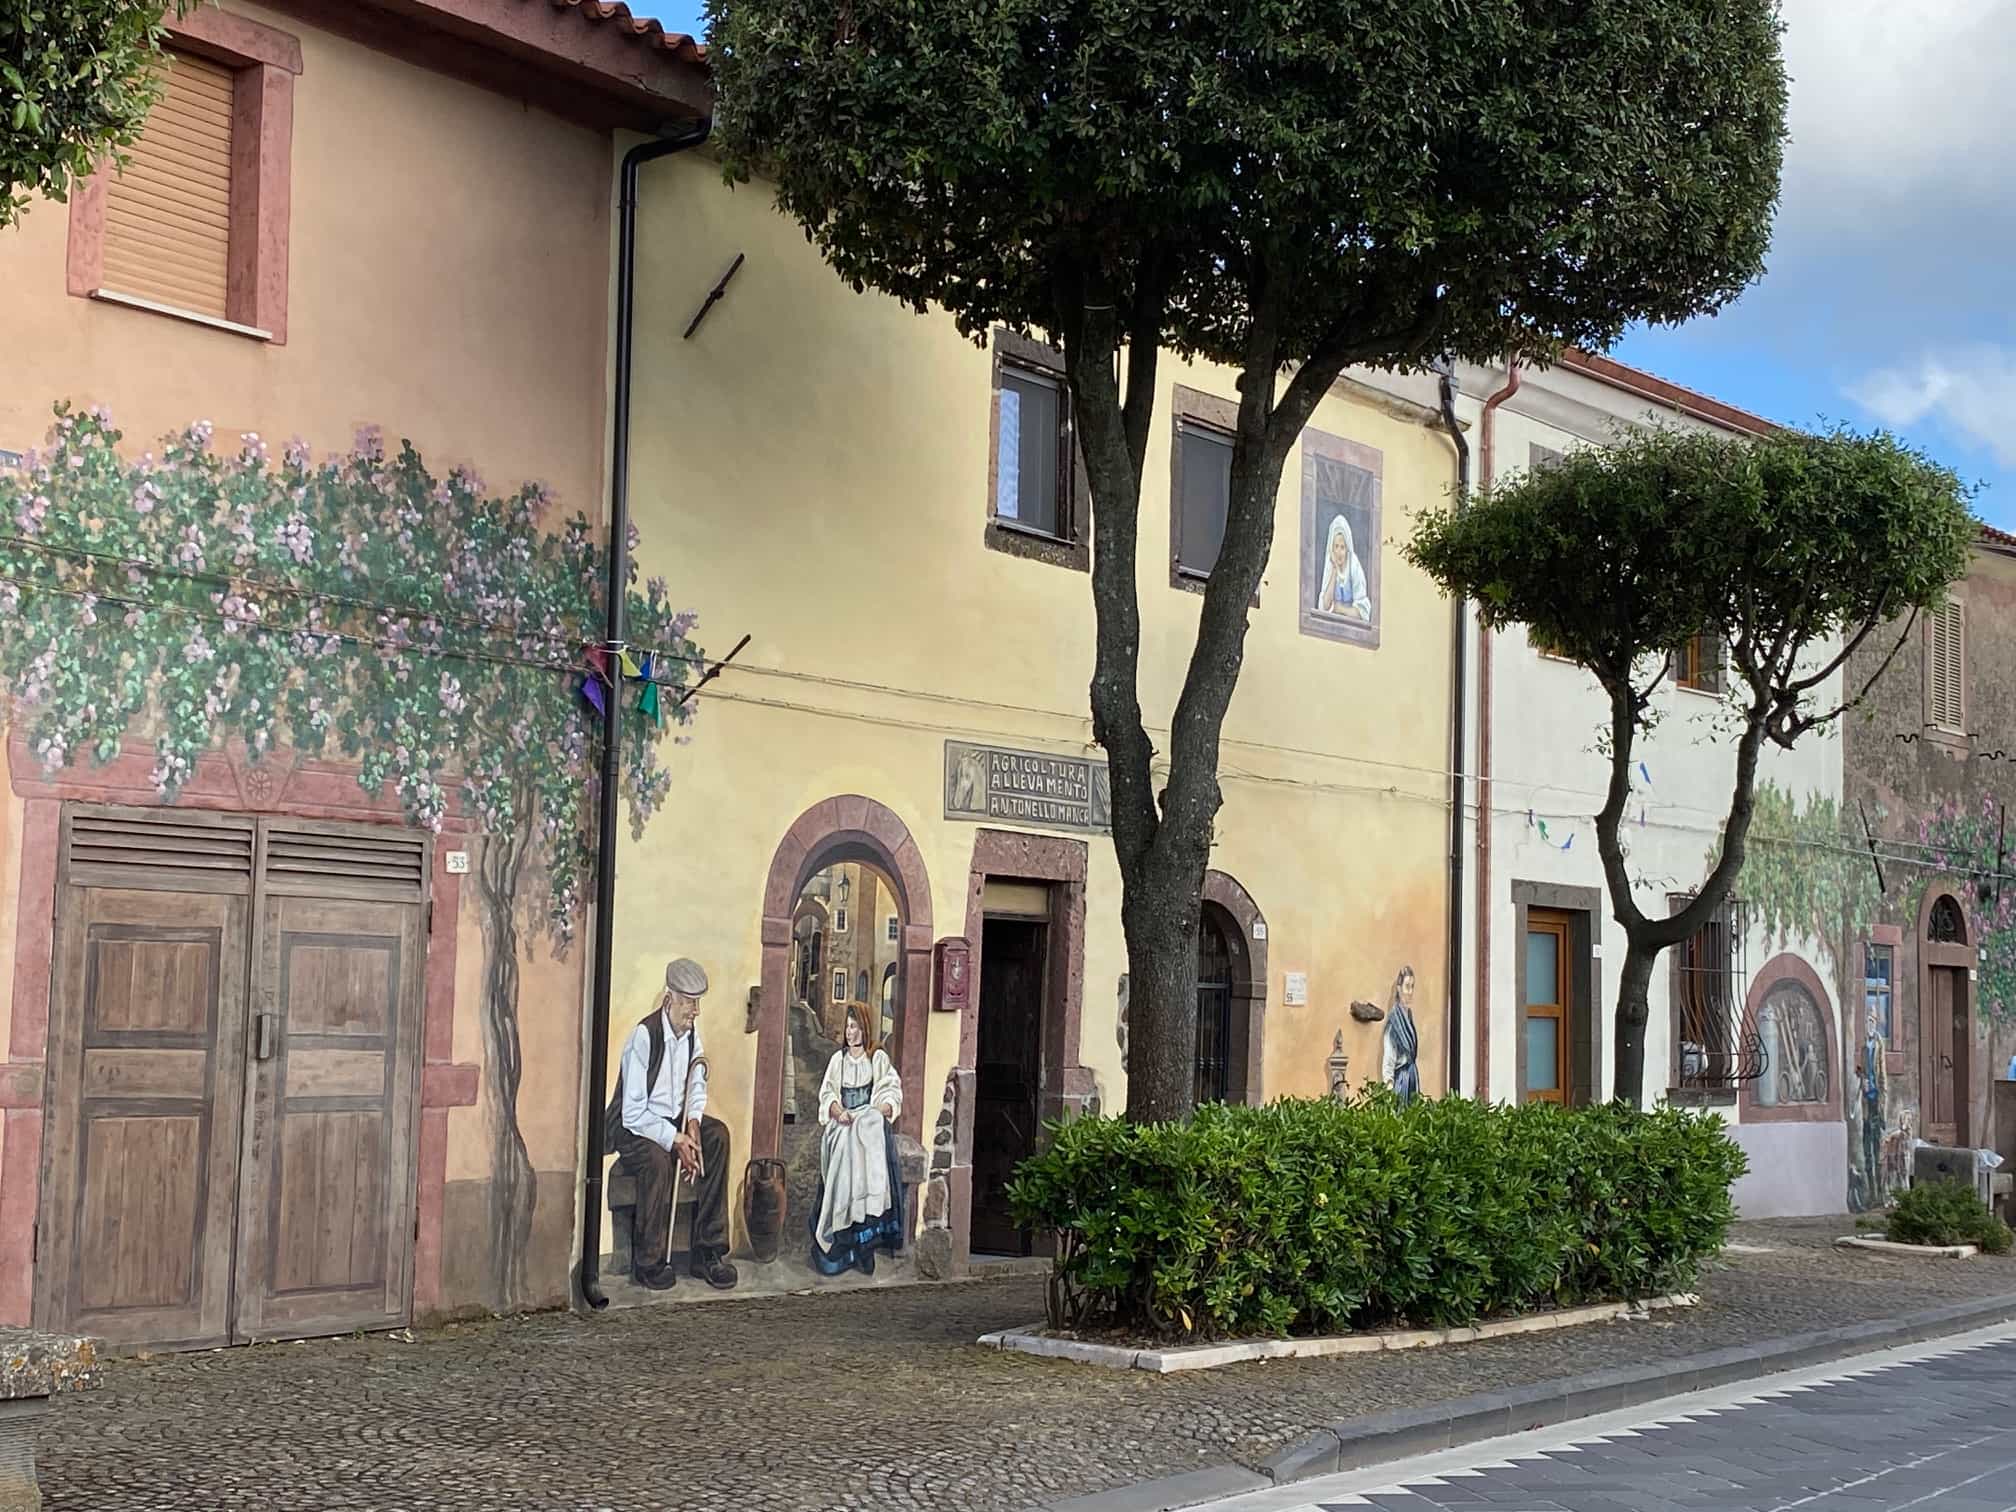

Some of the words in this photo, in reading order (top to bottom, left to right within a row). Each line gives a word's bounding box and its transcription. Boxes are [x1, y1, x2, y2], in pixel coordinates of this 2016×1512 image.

[991, 754, 1086, 783] AGRICOLTURA
[991, 774, 1088, 800] ALLEVAMENTO
[990, 797, 1057, 820] ANTONELLO
